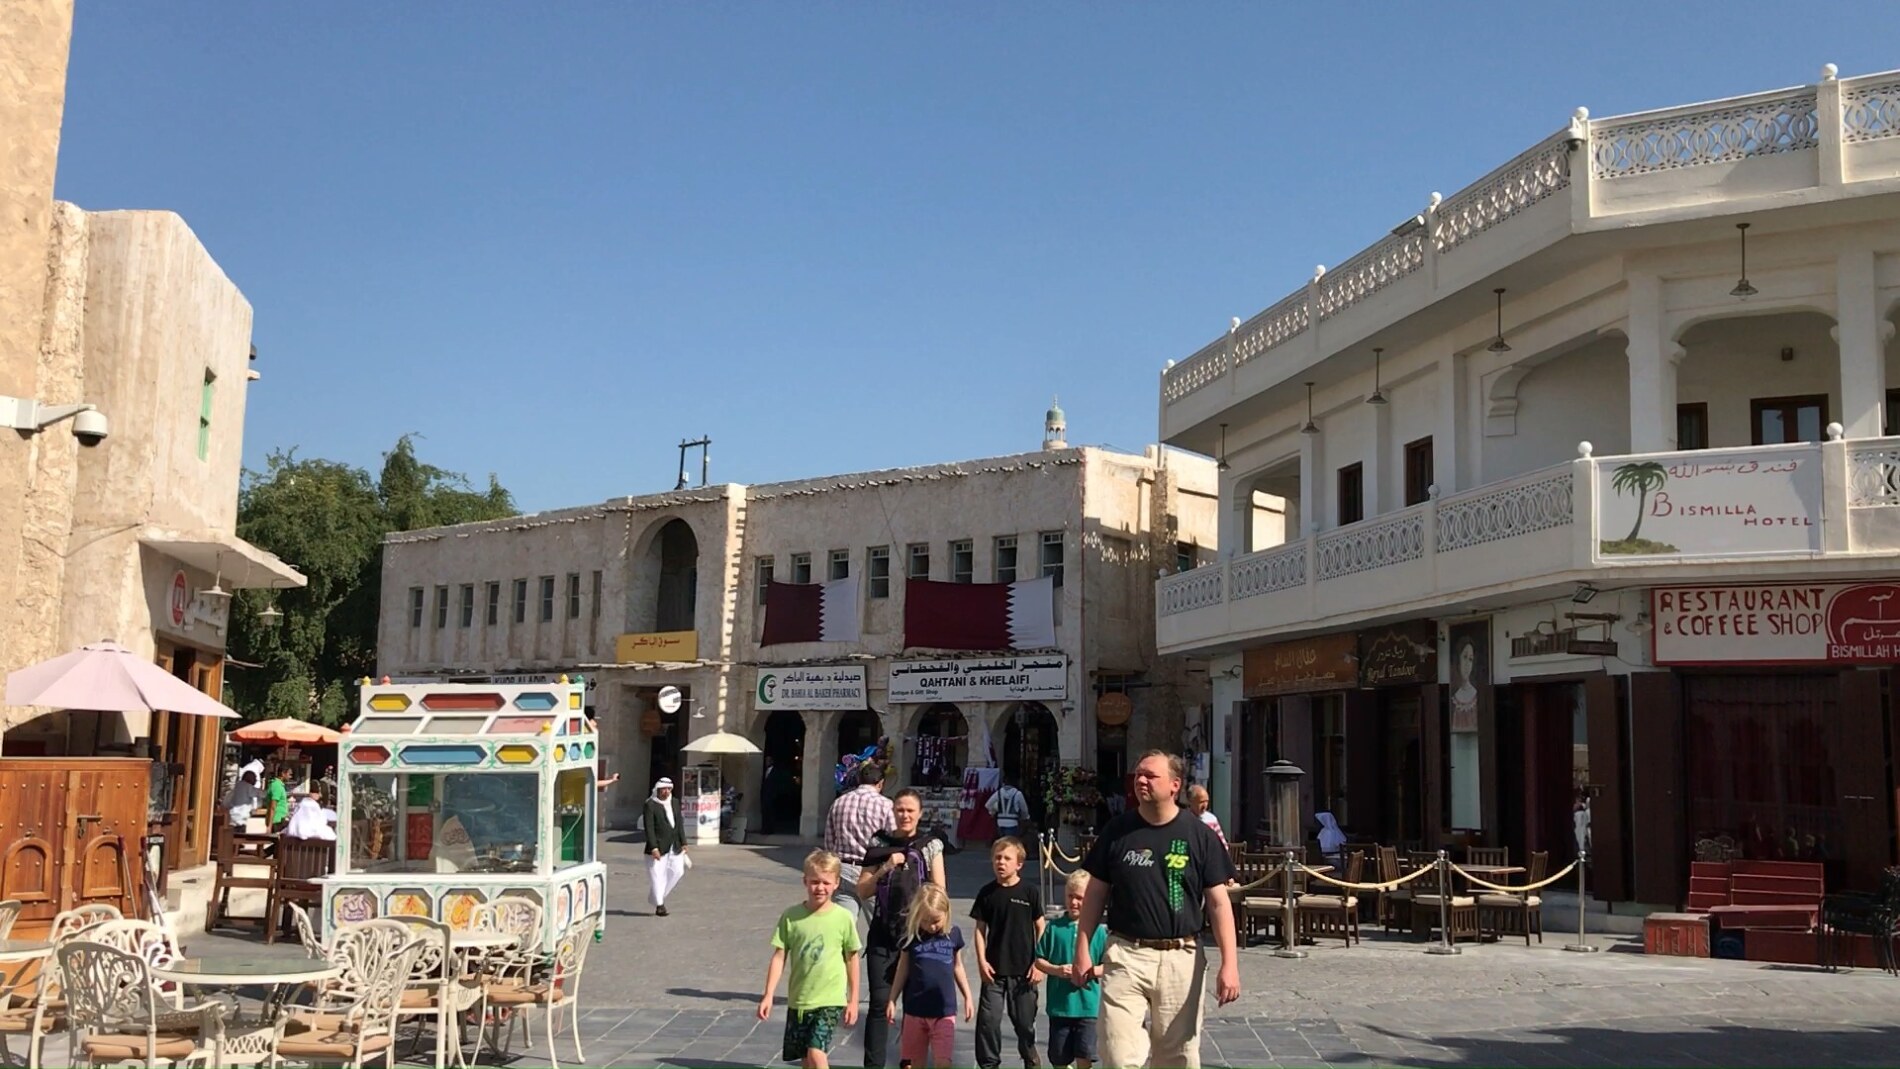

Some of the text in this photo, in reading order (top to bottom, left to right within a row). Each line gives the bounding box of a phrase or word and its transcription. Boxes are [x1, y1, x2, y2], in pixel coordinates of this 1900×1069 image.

[1668, 461, 1700, 479] الله
[1651, 492, 1757, 517] BISMILLA
[1744, 517, 1813, 526] HOTEL
[1660, 588, 1825, 613] RESTAURANT
[1664, 613, 1823, 636] & COFFEE SHOP
[1831, 644, 1890, 659] BISMILLAH
[963, 659, 1017, 675] الخليفي
[1019, 658, 1064, 673] متجر
[920, 674, 1030, 688] QAHTANI & KHELAIFI
